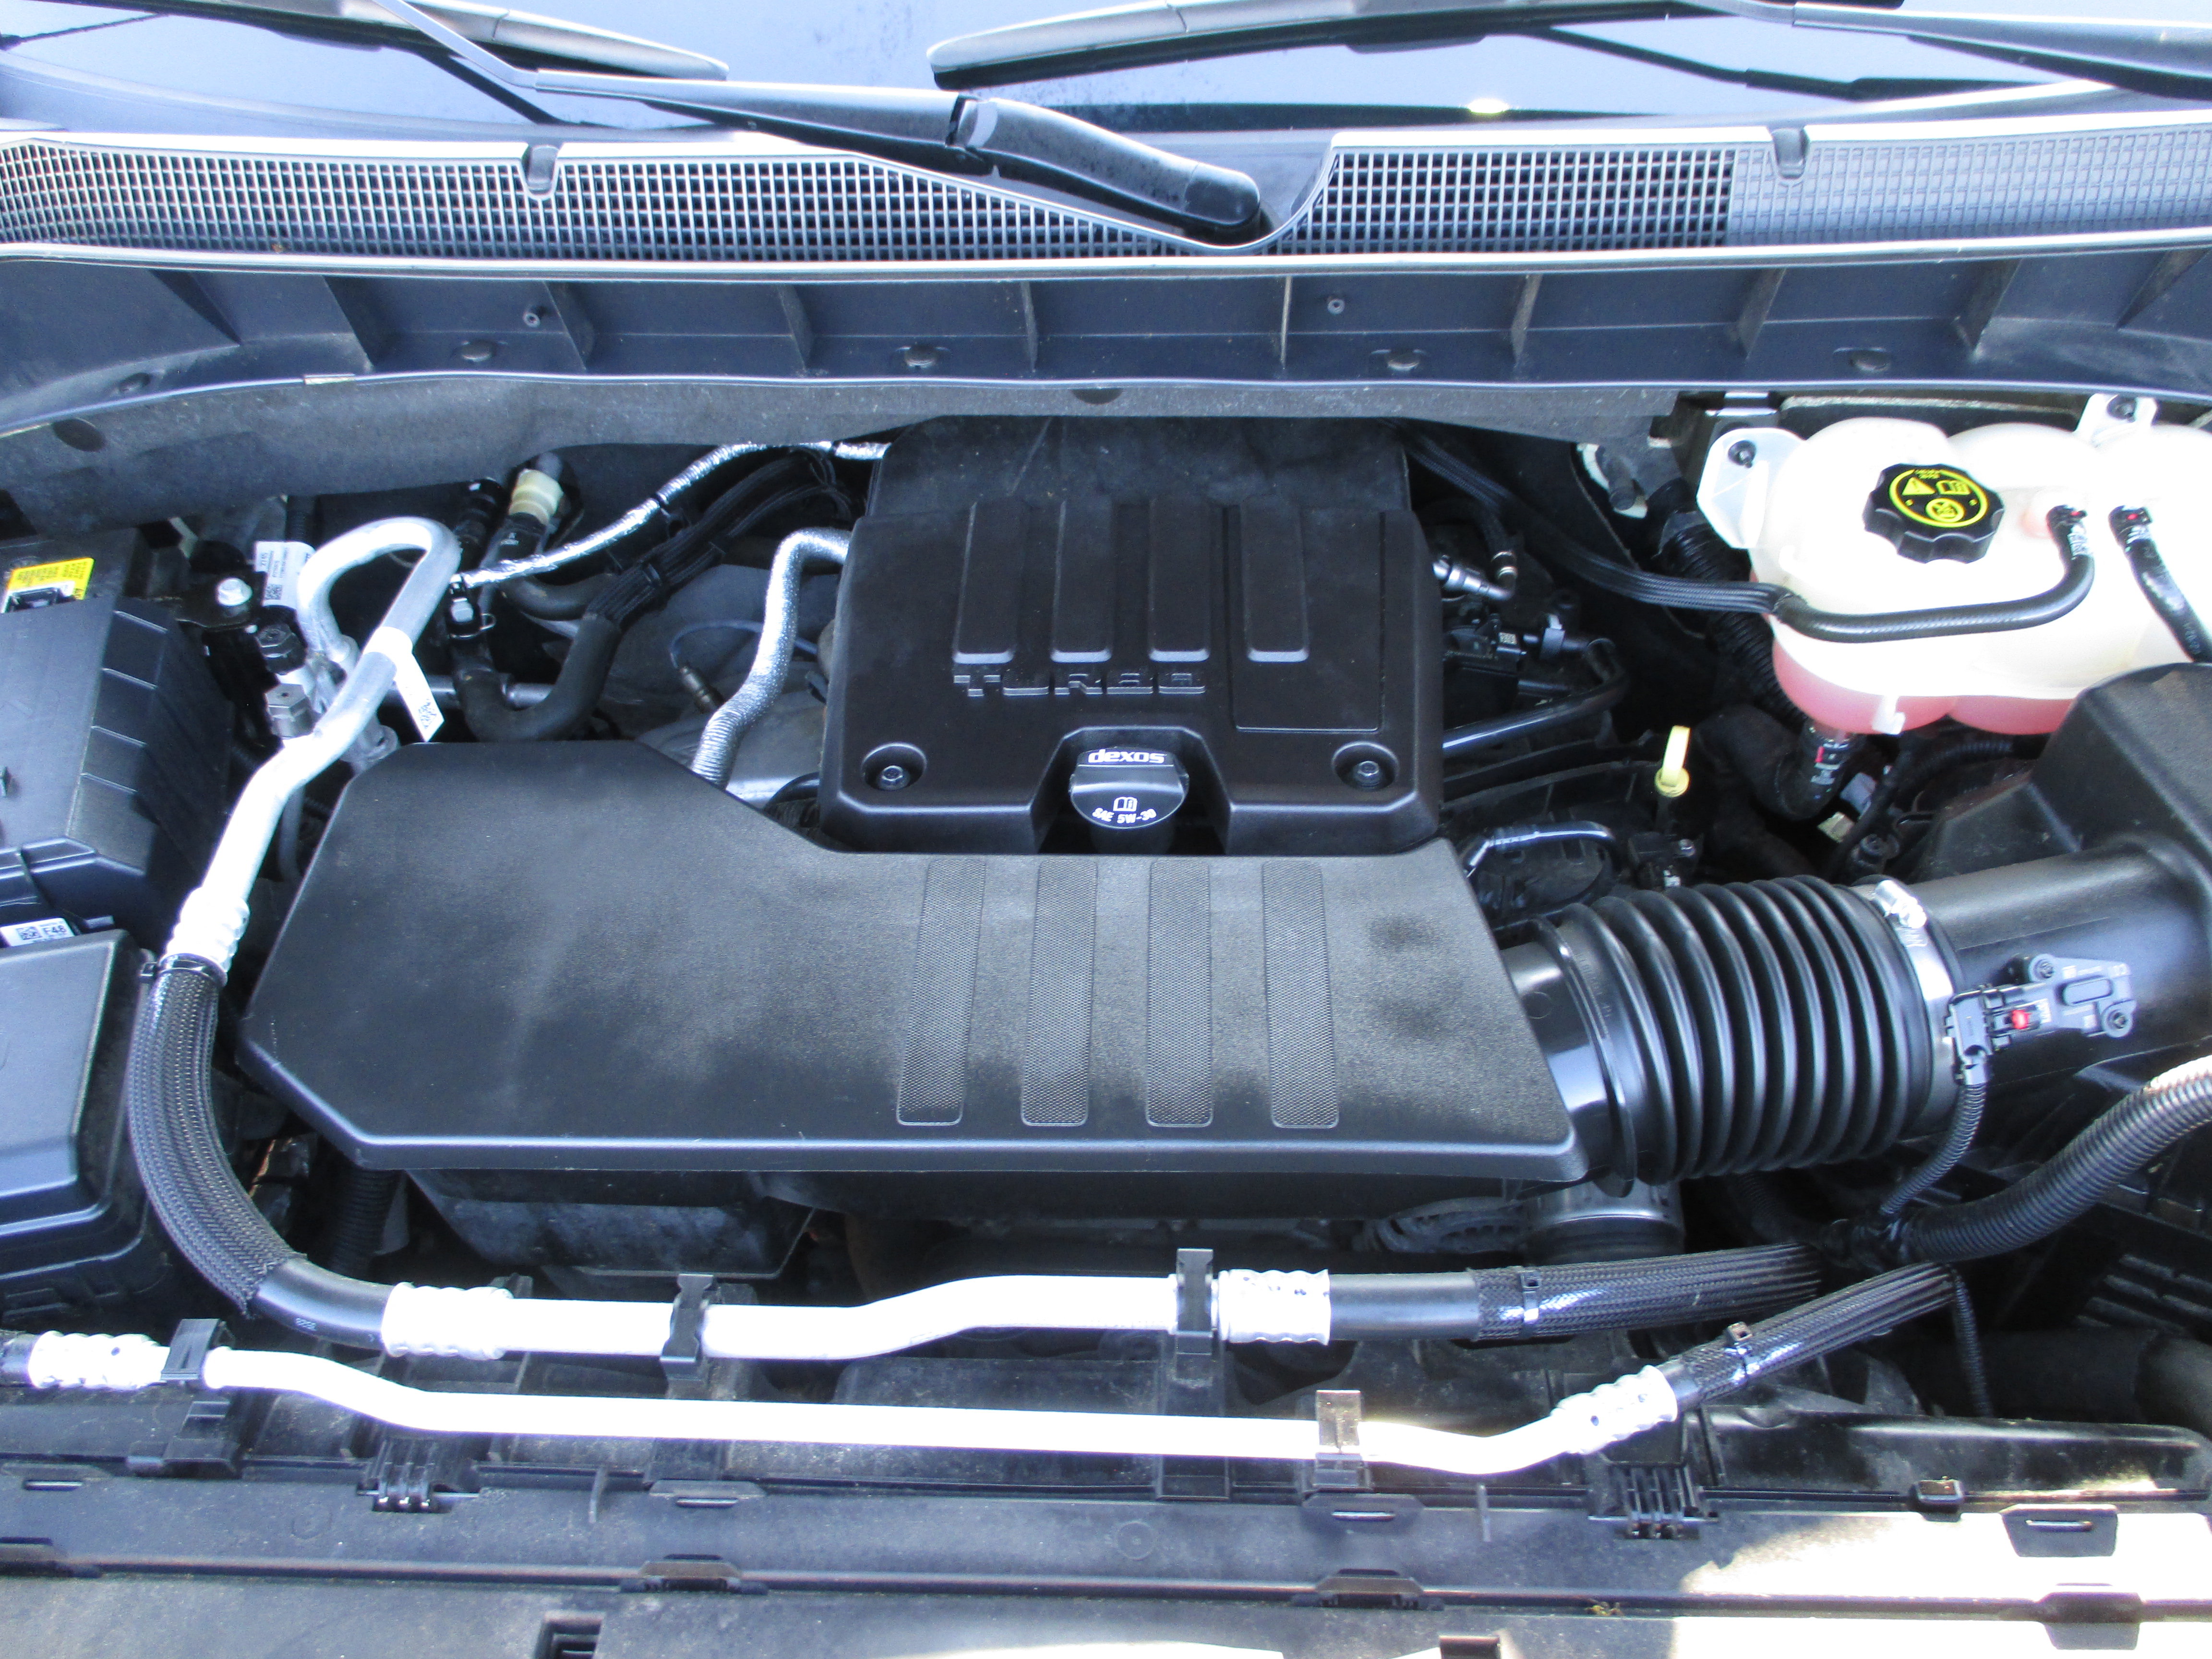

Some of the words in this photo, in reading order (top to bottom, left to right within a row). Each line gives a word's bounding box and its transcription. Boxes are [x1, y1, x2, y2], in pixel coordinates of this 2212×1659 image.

[954, 671, 1206, 697] TURBO
[1088, 748, 1167, 764] dexos
[1092, 807, 1115, 822] SAE
[1117, 808, 1157, 824] 5W-30
